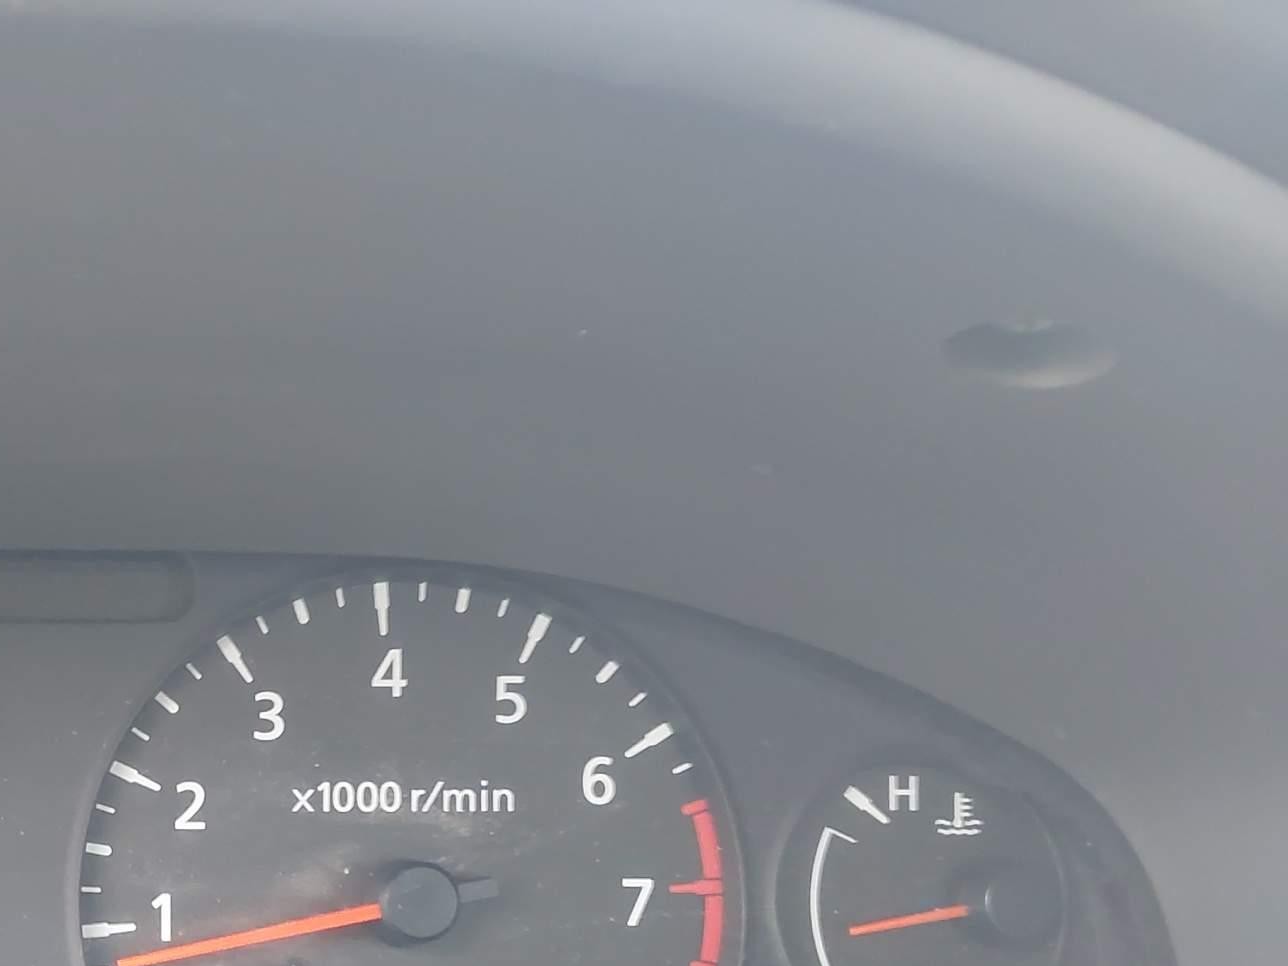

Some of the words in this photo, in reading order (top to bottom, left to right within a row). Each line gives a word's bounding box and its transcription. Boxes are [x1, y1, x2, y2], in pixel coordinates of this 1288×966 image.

[372, 649, 407, 697] 4
[254, 692, 284, 740] 3
[496, 676, 526, 723] 5
[292, 782, 401, 812] x1000
[411, 780, 514, 812] r/min
[583, 757, 614, 805] 6
[889, 776, 918, 811] H
[175, 782, 205, 829] 2
[152, 893, 171, 941] 1
[622, 879, 654, 926] 7
